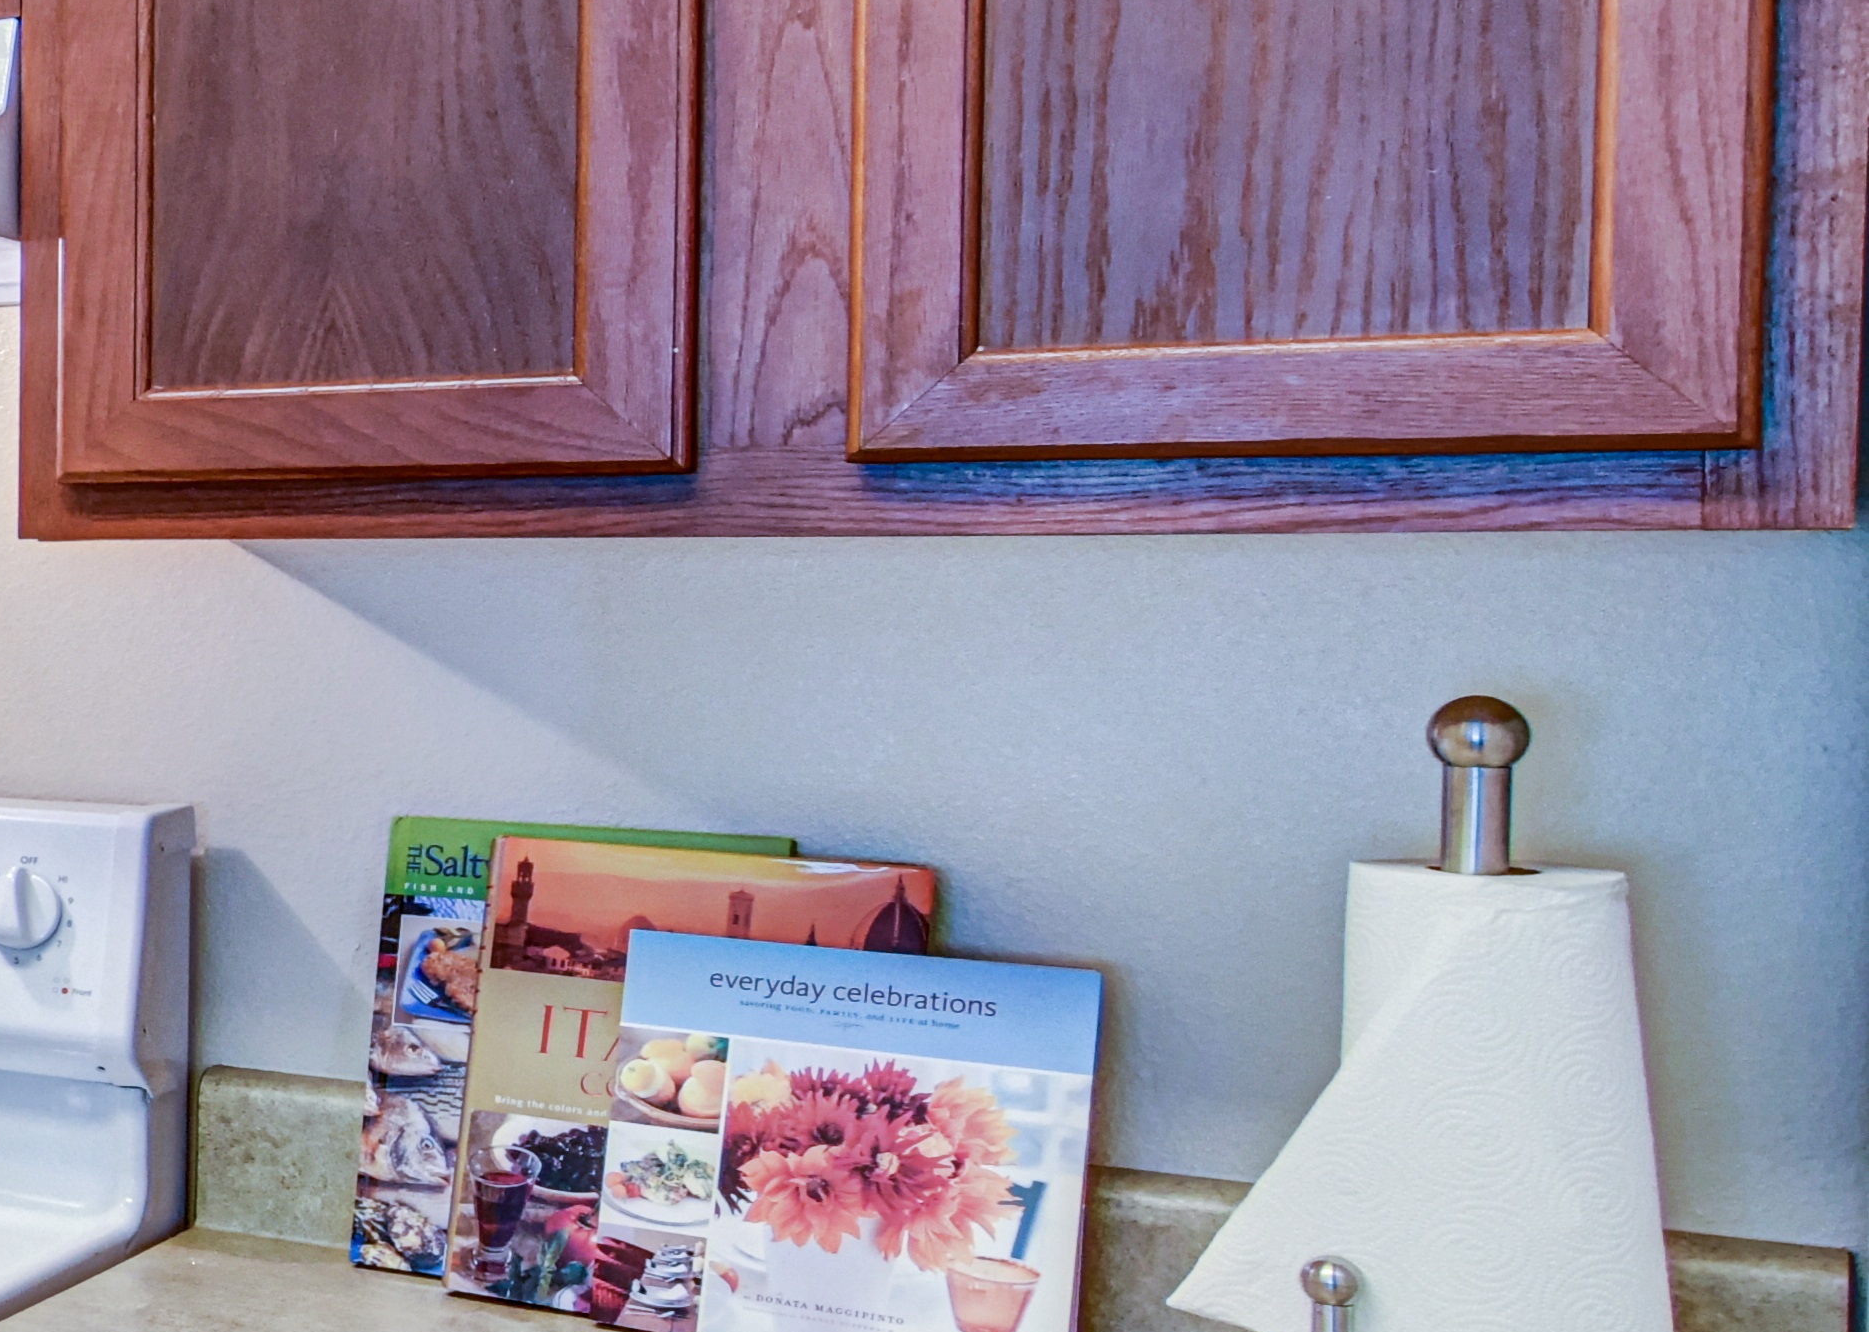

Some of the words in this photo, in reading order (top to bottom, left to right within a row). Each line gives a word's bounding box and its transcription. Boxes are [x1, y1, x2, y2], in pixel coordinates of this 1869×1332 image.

[20, 855, 38, 865] OFF
[406, 844, 422, 874] THE
[58, 875, 68, 883] HI
[404, 882, 437, 892] FISH
[447, 885, 474, 895] AND
[709, 971, 826, 1004] everyday
[832, 982, 998, 1017] celebrations
[494, 1094, 524, 1108] Bring
[527, 1099, 545, 1109] the
[548, 1104, 583, 1115] colors
[586, 1108, 608, 1117] and
[756, 1294, 809, 1309] DONATA
[815, 1304, 905, 1325] MAGGIPINTO
